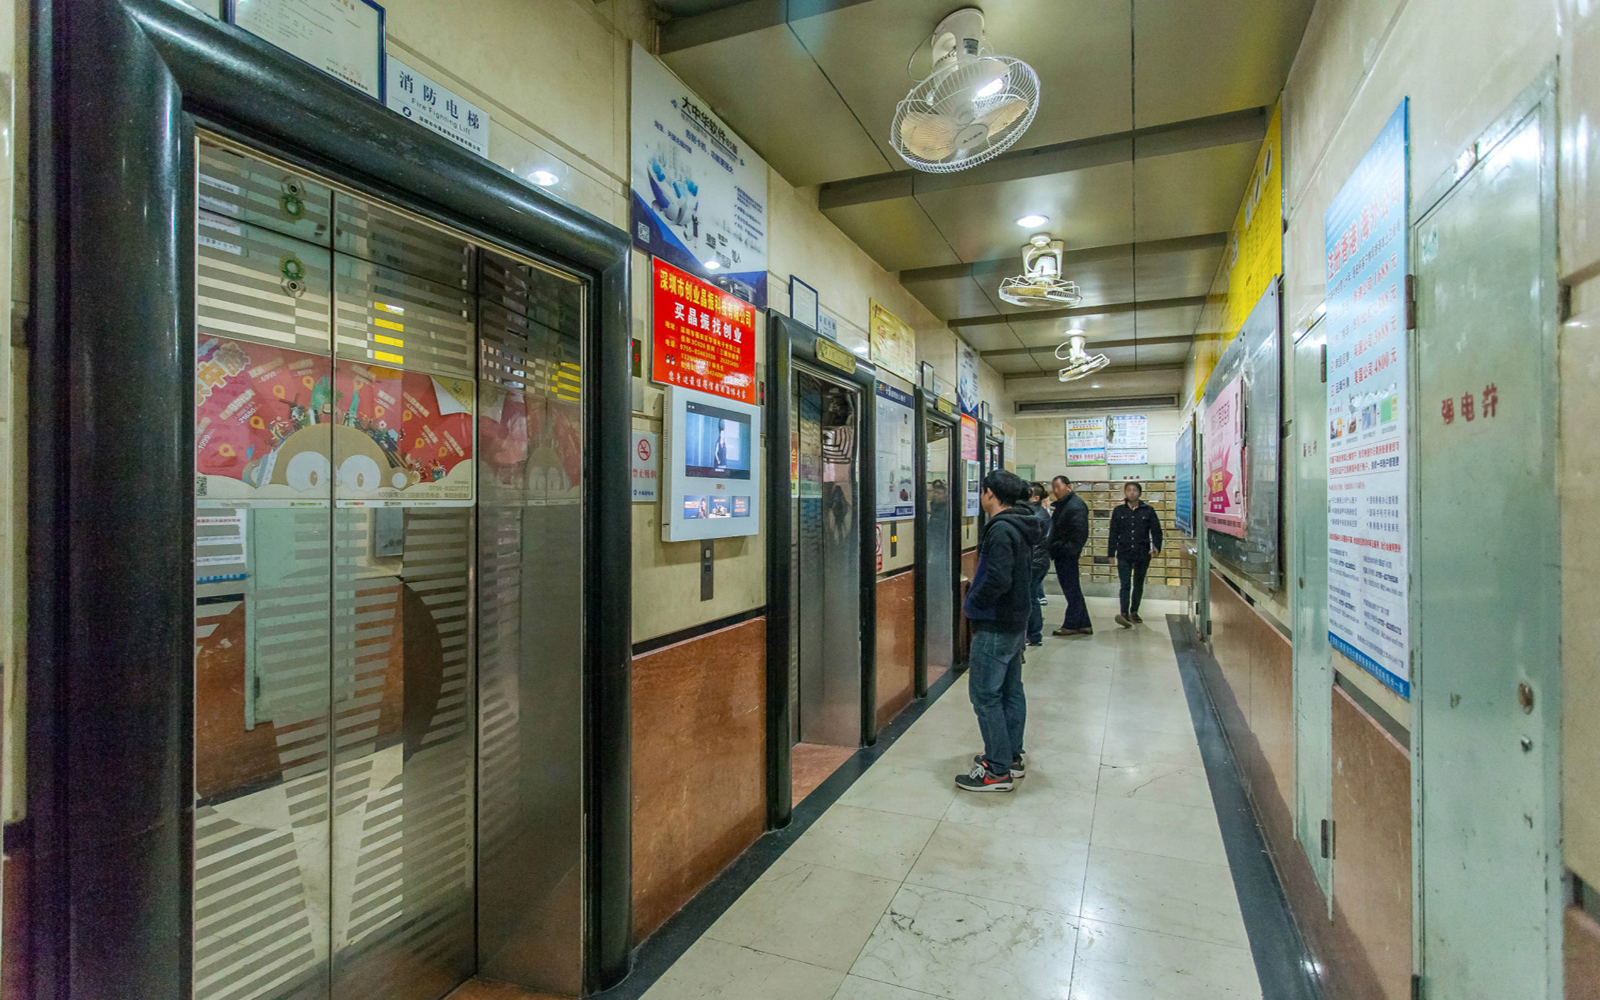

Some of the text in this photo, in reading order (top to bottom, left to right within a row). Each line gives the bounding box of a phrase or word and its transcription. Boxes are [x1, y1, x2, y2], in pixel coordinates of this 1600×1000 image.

[399, 70, 479, 129] 消防电梯
[411, 98, 470, 135] Fire Fighting Lift
[659, 269, 751, 328] 深圳市创业晶振科技有限公司
[674, 301, 742, 344] 买晶振找创业
[634, 353, 639, 363] 5
